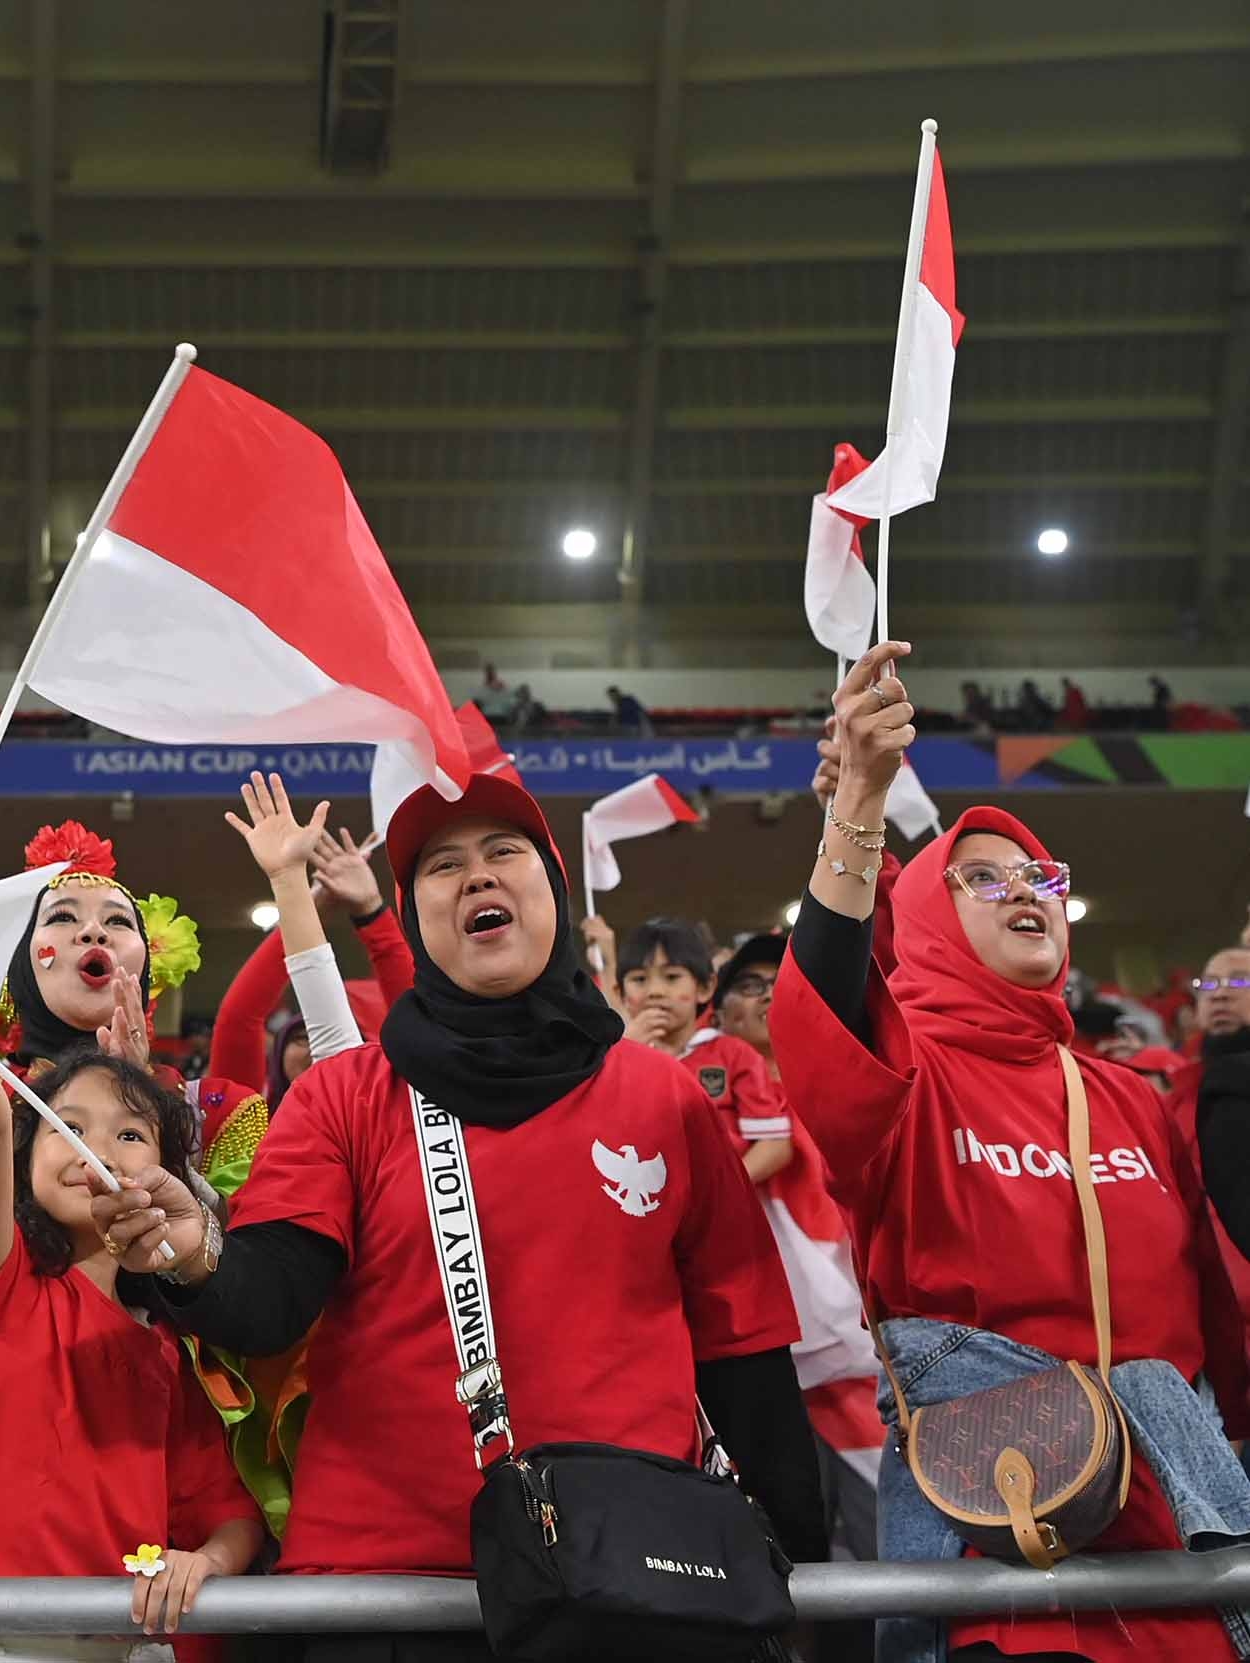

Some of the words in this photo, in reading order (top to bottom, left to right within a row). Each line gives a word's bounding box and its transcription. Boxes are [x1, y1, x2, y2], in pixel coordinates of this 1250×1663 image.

[88, 751, 184, 773] ASIAN
[191, 751, 257, 773] CUP
[429, 1138, 465, 1215] LOLA
[694, 1564, 727, 1580] LOLA
